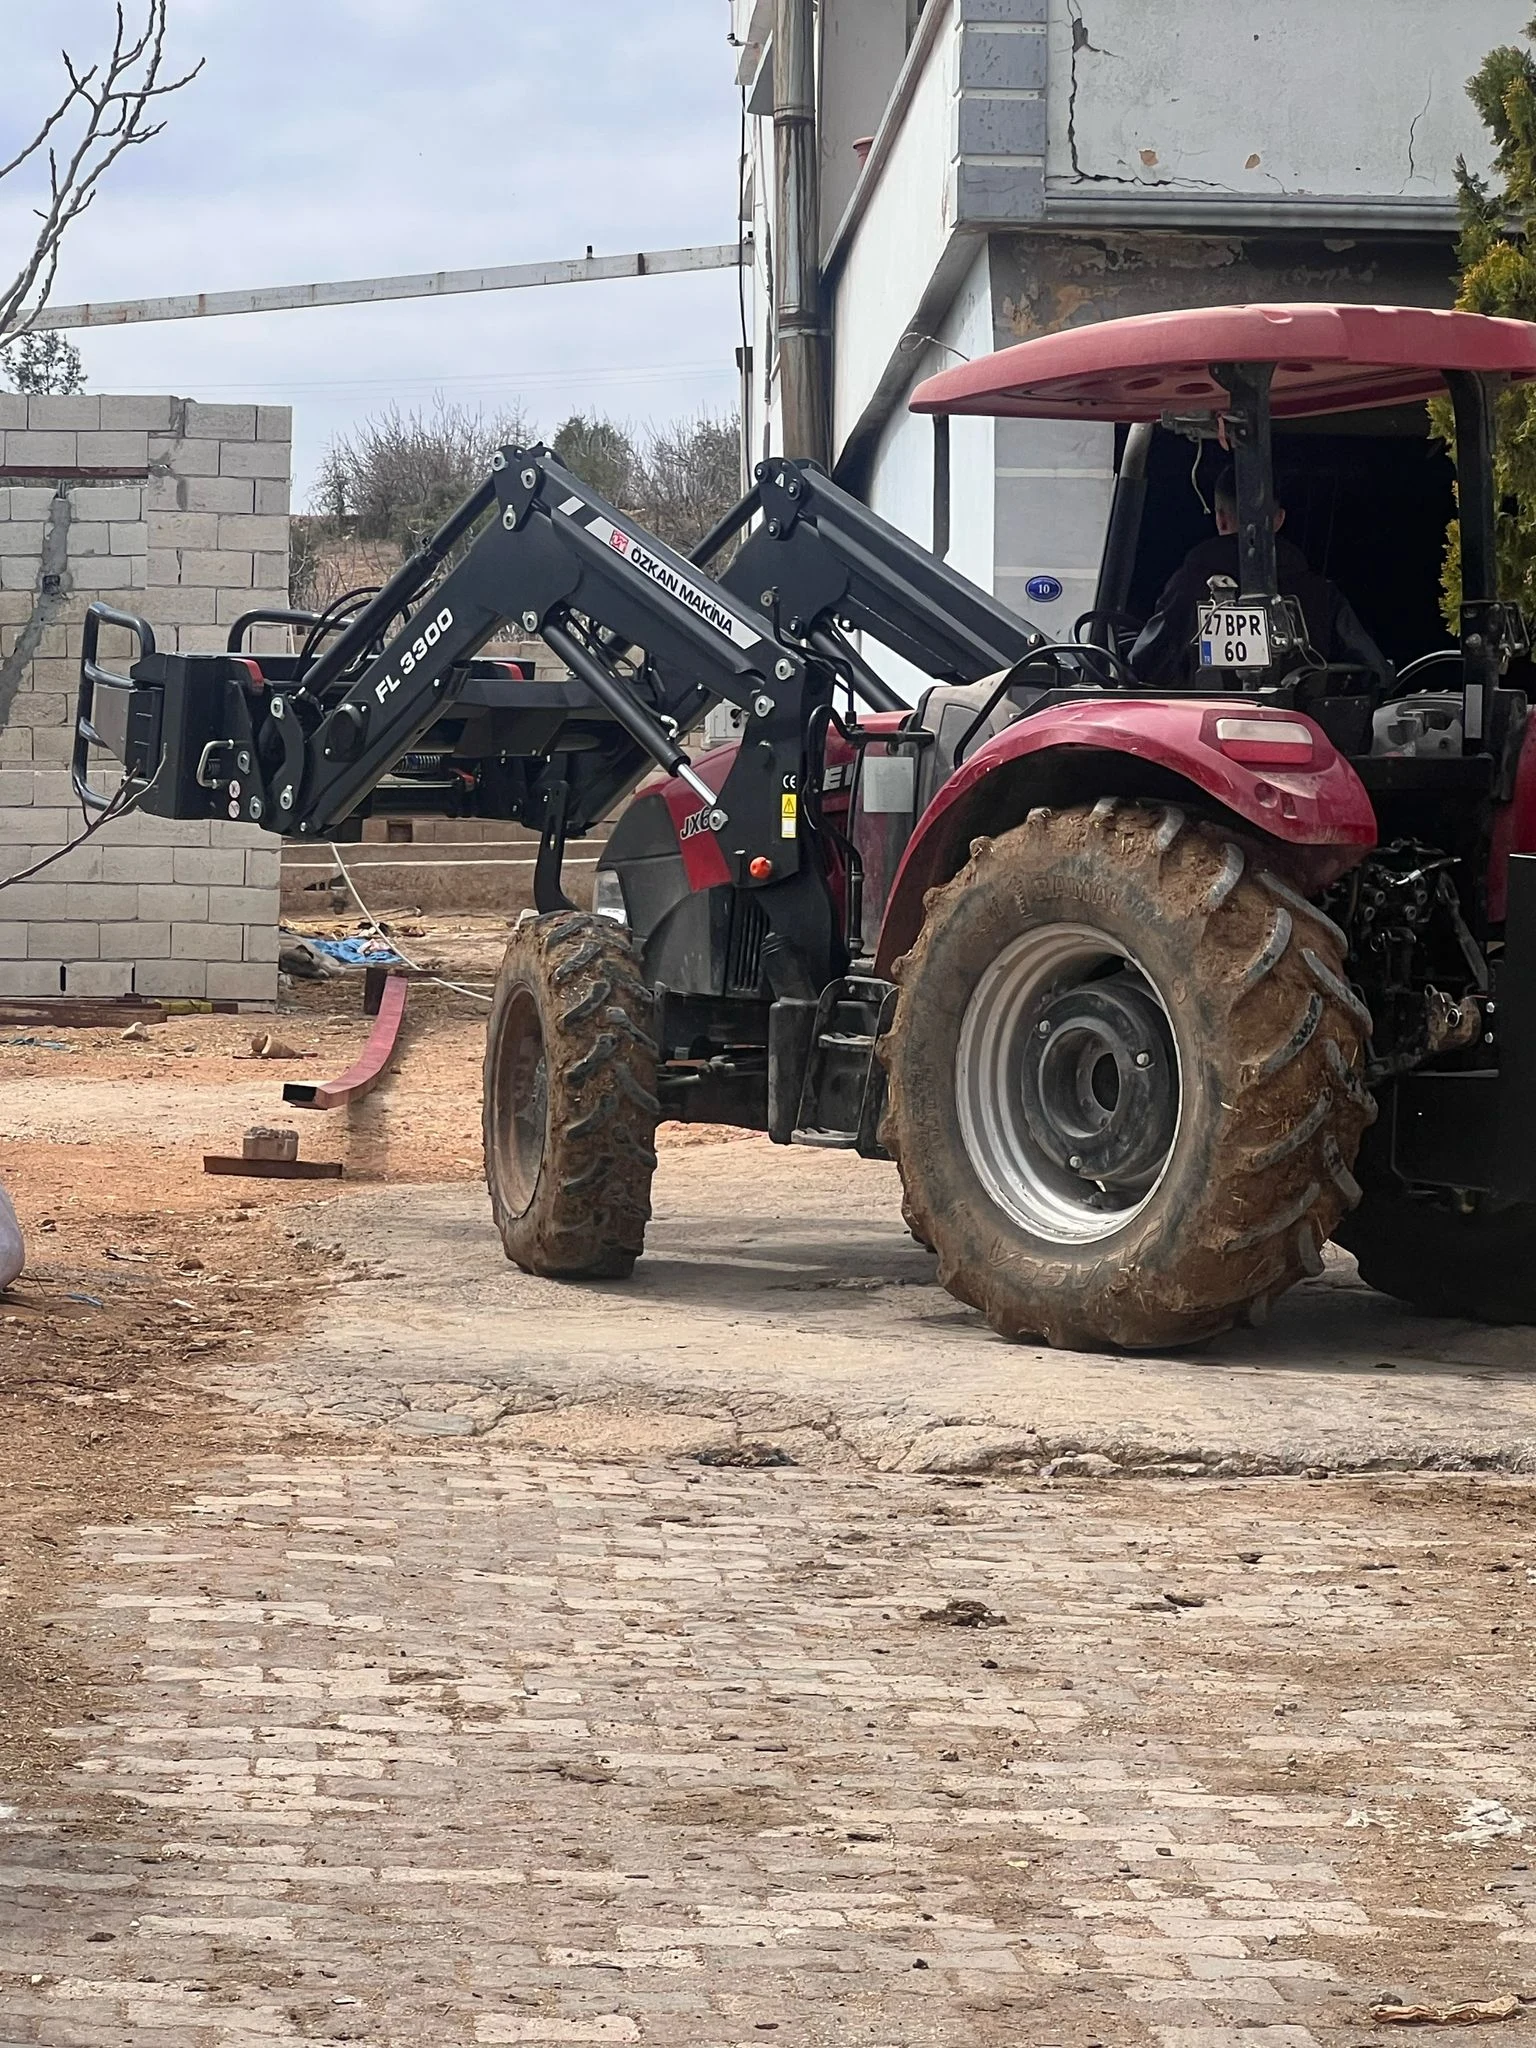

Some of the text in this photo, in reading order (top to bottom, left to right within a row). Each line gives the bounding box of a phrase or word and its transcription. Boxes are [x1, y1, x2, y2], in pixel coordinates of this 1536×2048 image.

[631, 546, 733, 636] ÖZKAN MAKİNA
[1038, 584, 1050, 594] 10
[1204, 613, 1261, 636] 27 BPR
[375, 607, 453, 704] FL 3300
[1224, 641, 1247, 662] 60
[782, 774, 797, 789] CE
